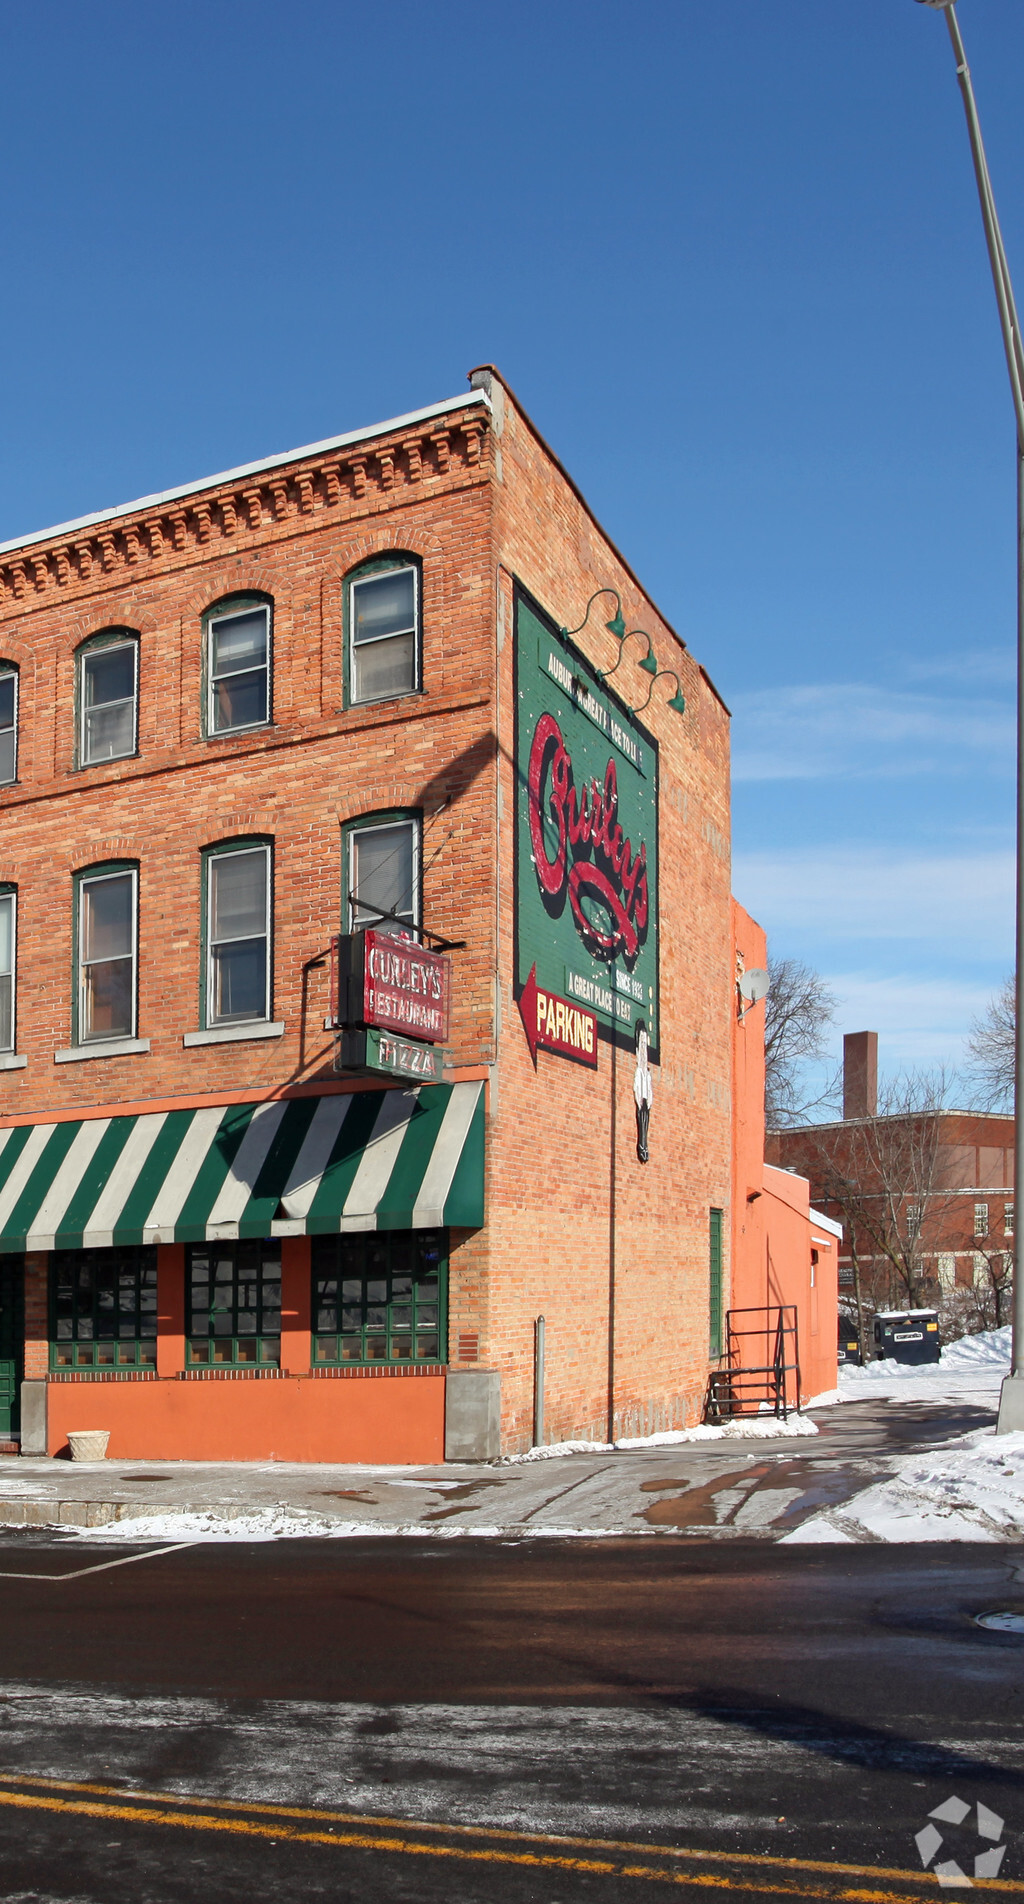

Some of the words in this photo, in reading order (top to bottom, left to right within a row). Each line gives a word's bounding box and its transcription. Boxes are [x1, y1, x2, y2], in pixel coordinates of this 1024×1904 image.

[548, 652, 577, 698] AUBUR
[622, 732, 631, 755] TO
[528, 711, 647, 956] Curley's
[369, 948, 443, 999] CURLEY'S
[568, 971, 574, 993] A
[574, 974, 594, 1002] GREAT
[594, 985, 613, 1013] PLACE
[620, 999, 631, 1021] EAT
[616, 969, 631, 993] SINCE
[369, 989, 443, 1030] RESTAURANT
[537, 992, 594, 1054] PARKING
[379, 1037, 436, 1075] PIZZA
